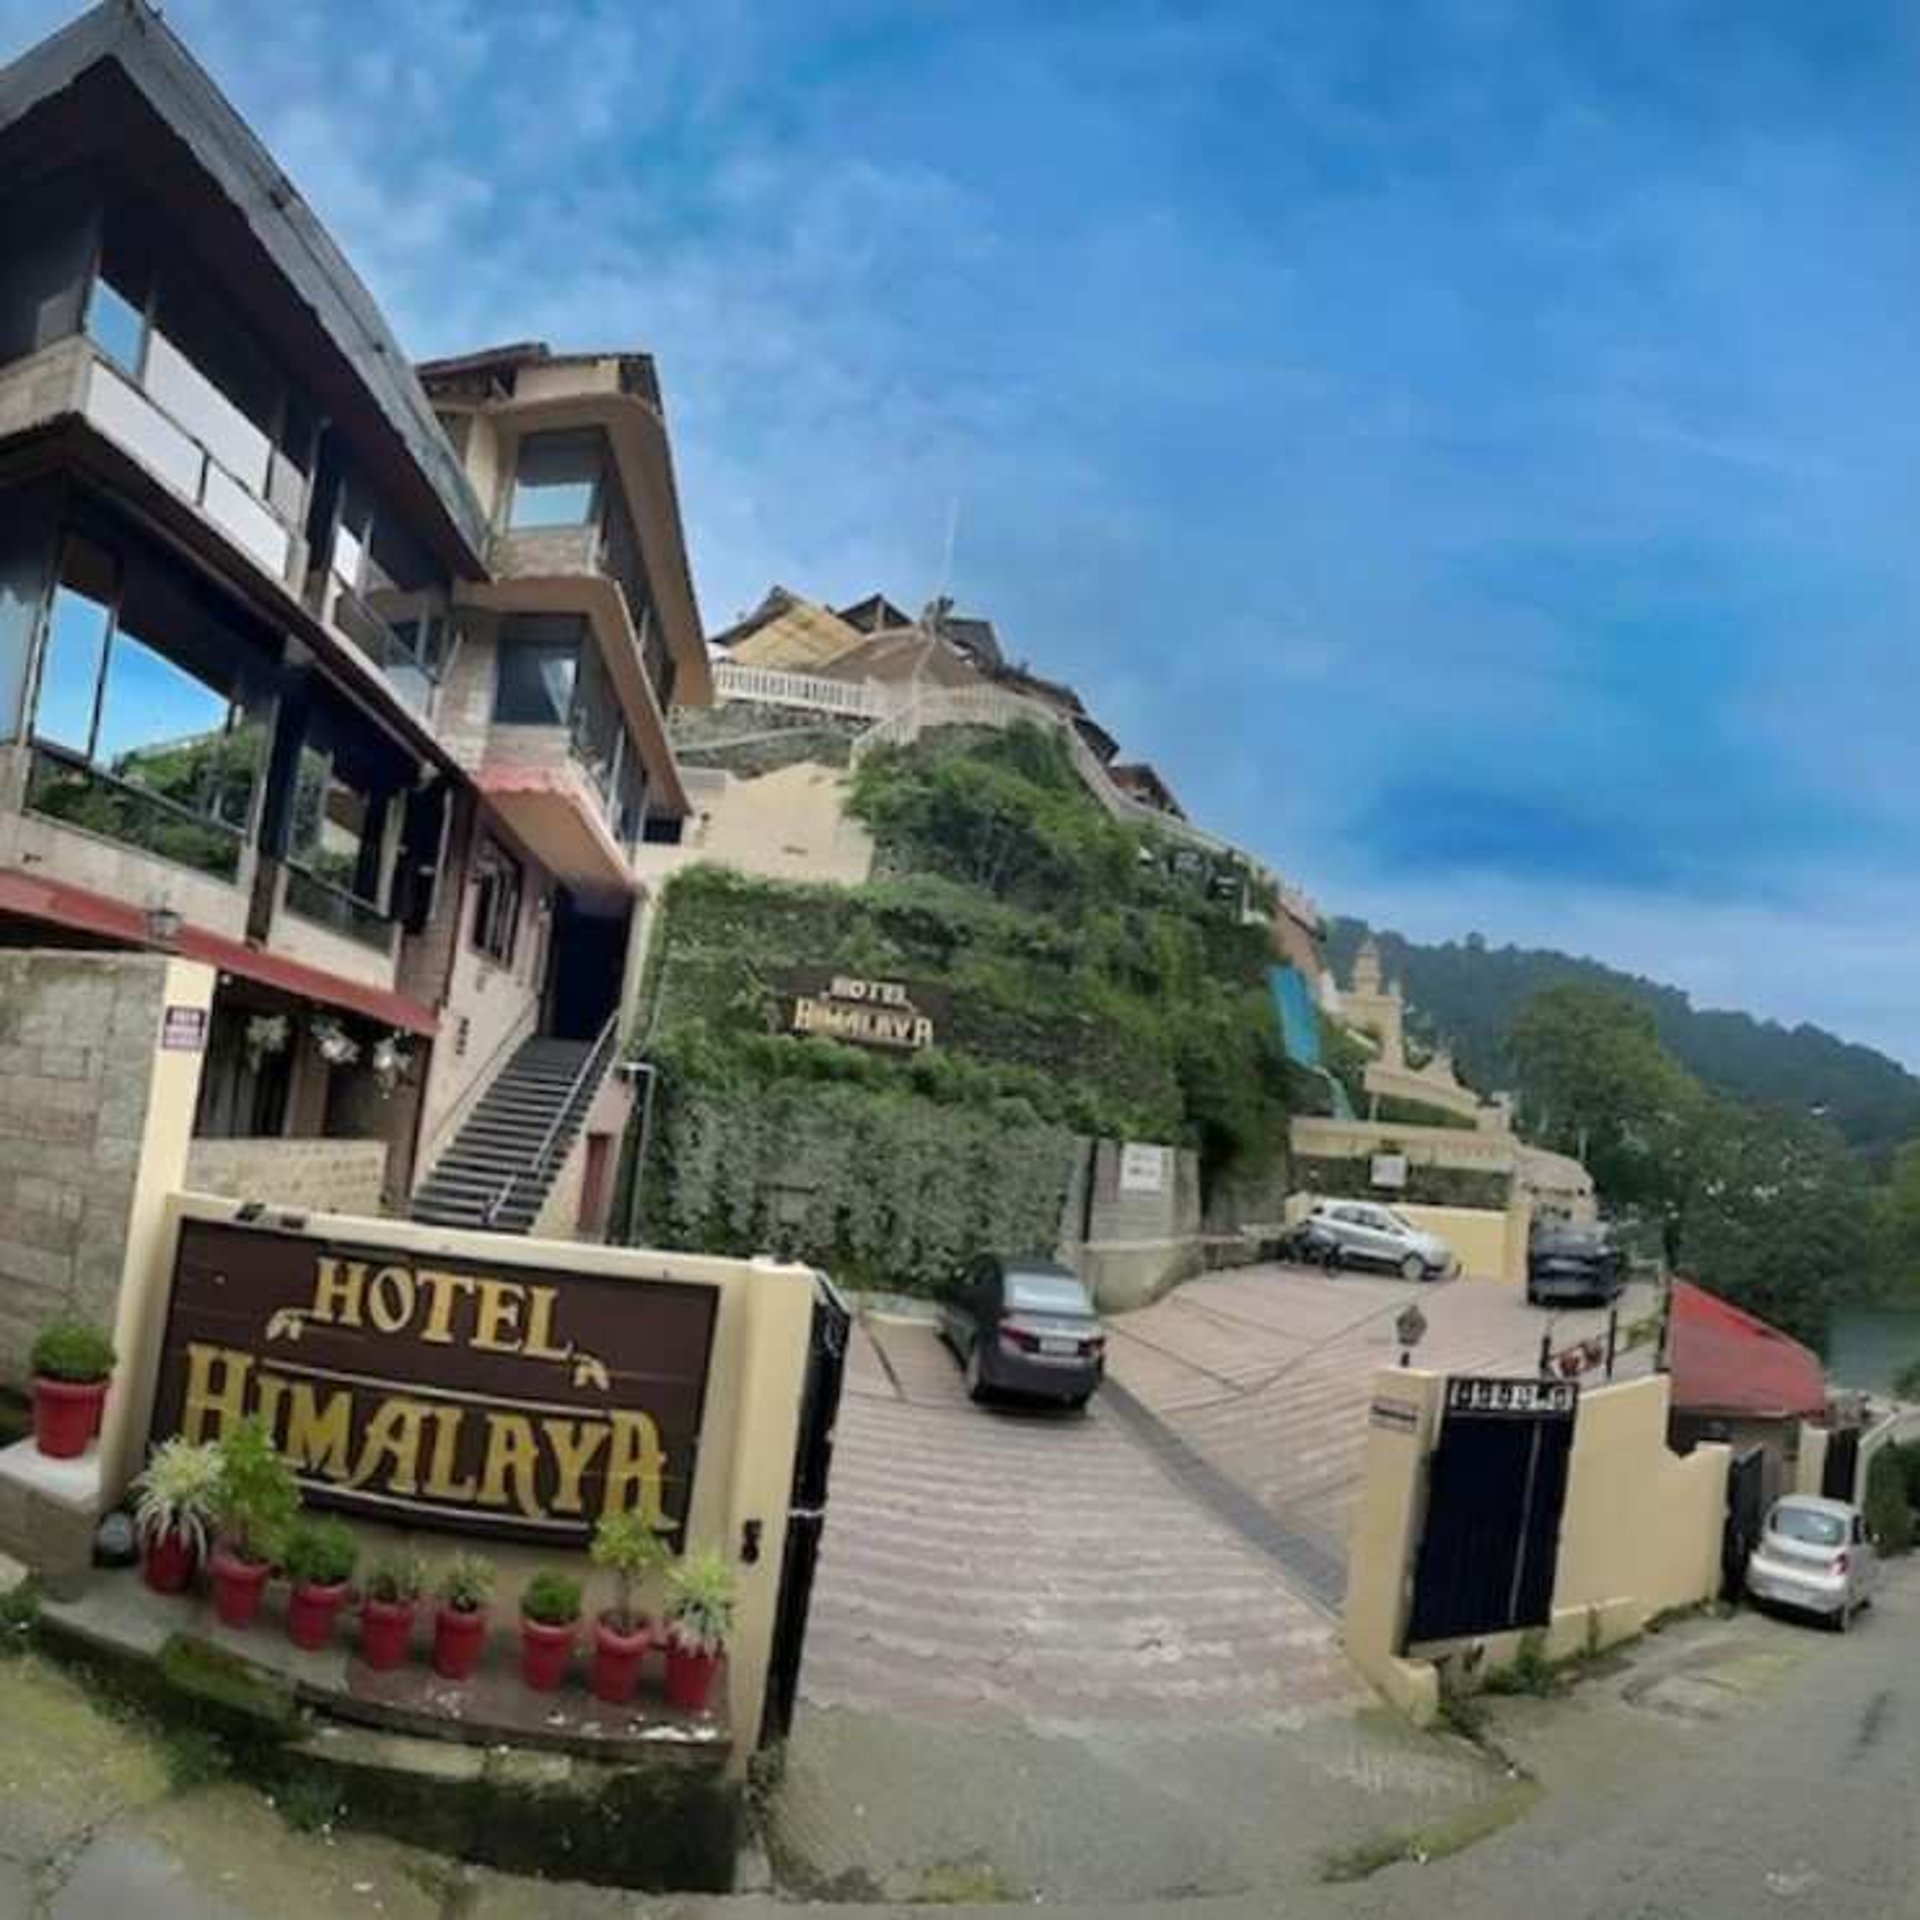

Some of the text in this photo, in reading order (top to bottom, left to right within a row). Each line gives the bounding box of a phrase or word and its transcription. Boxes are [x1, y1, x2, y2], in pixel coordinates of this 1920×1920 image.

[831, 976, 908, 1005] HOTEL
[313, 1257, 573, 1361] HOTEL
[182, 1341, 679, 1530] HIMALAYA
